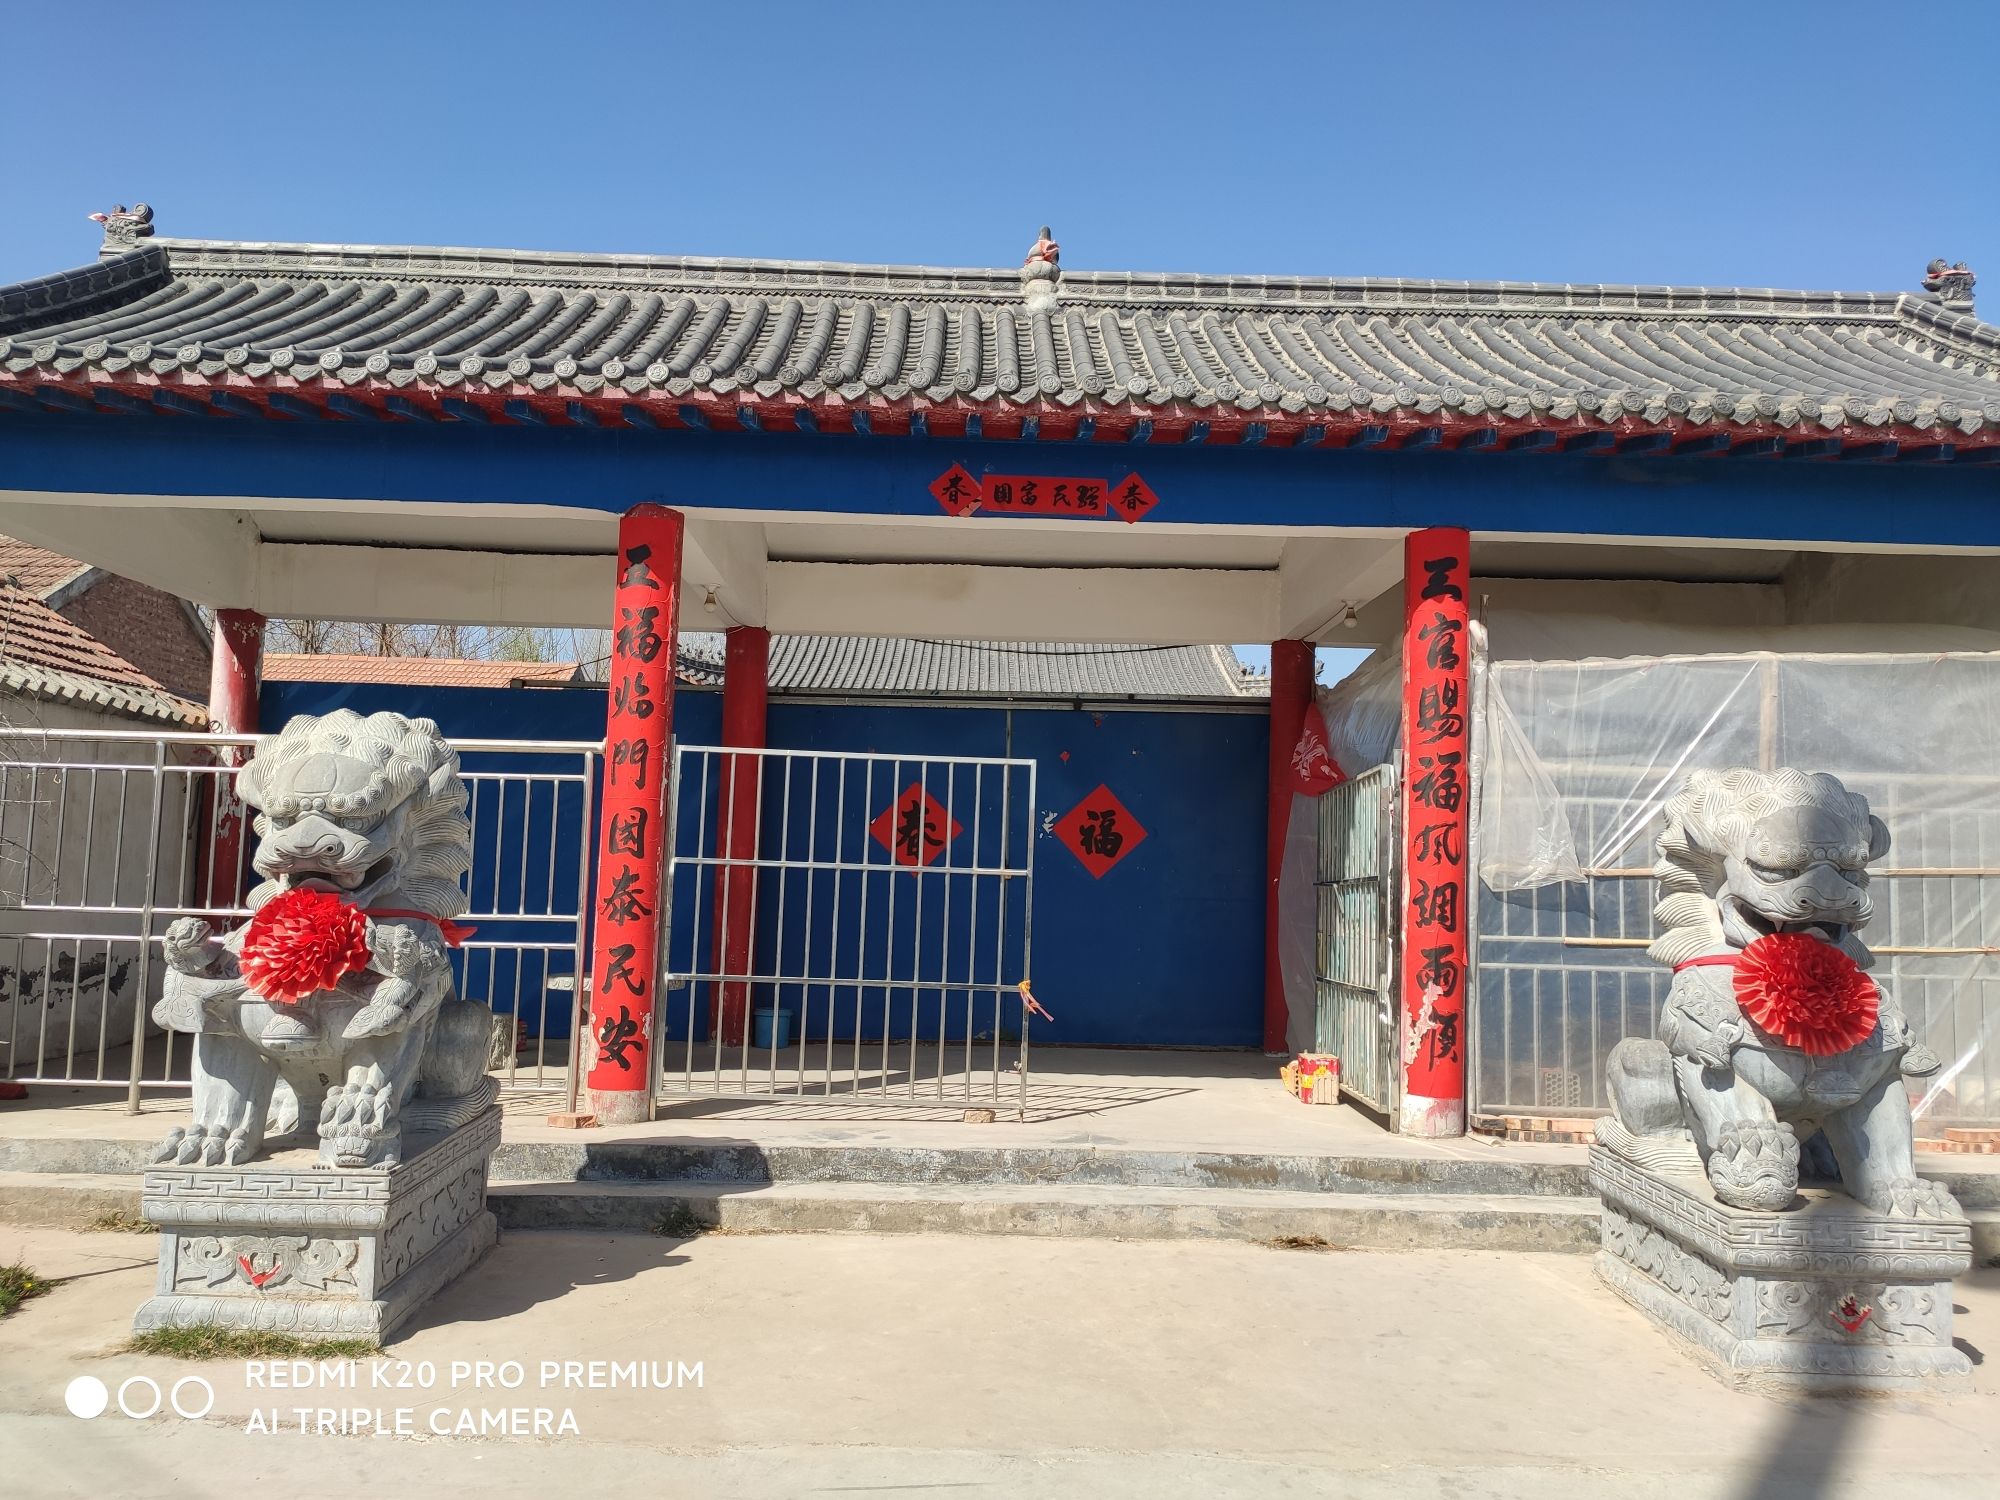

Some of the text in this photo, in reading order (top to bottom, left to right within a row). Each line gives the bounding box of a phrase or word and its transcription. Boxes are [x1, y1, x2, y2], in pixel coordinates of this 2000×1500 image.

[941, 474, 971, 505] 春
[1119, 481, 1149, 512] 春
[896, 799, 944, 862] 春
[1079, 809, 1124, 858] 福
